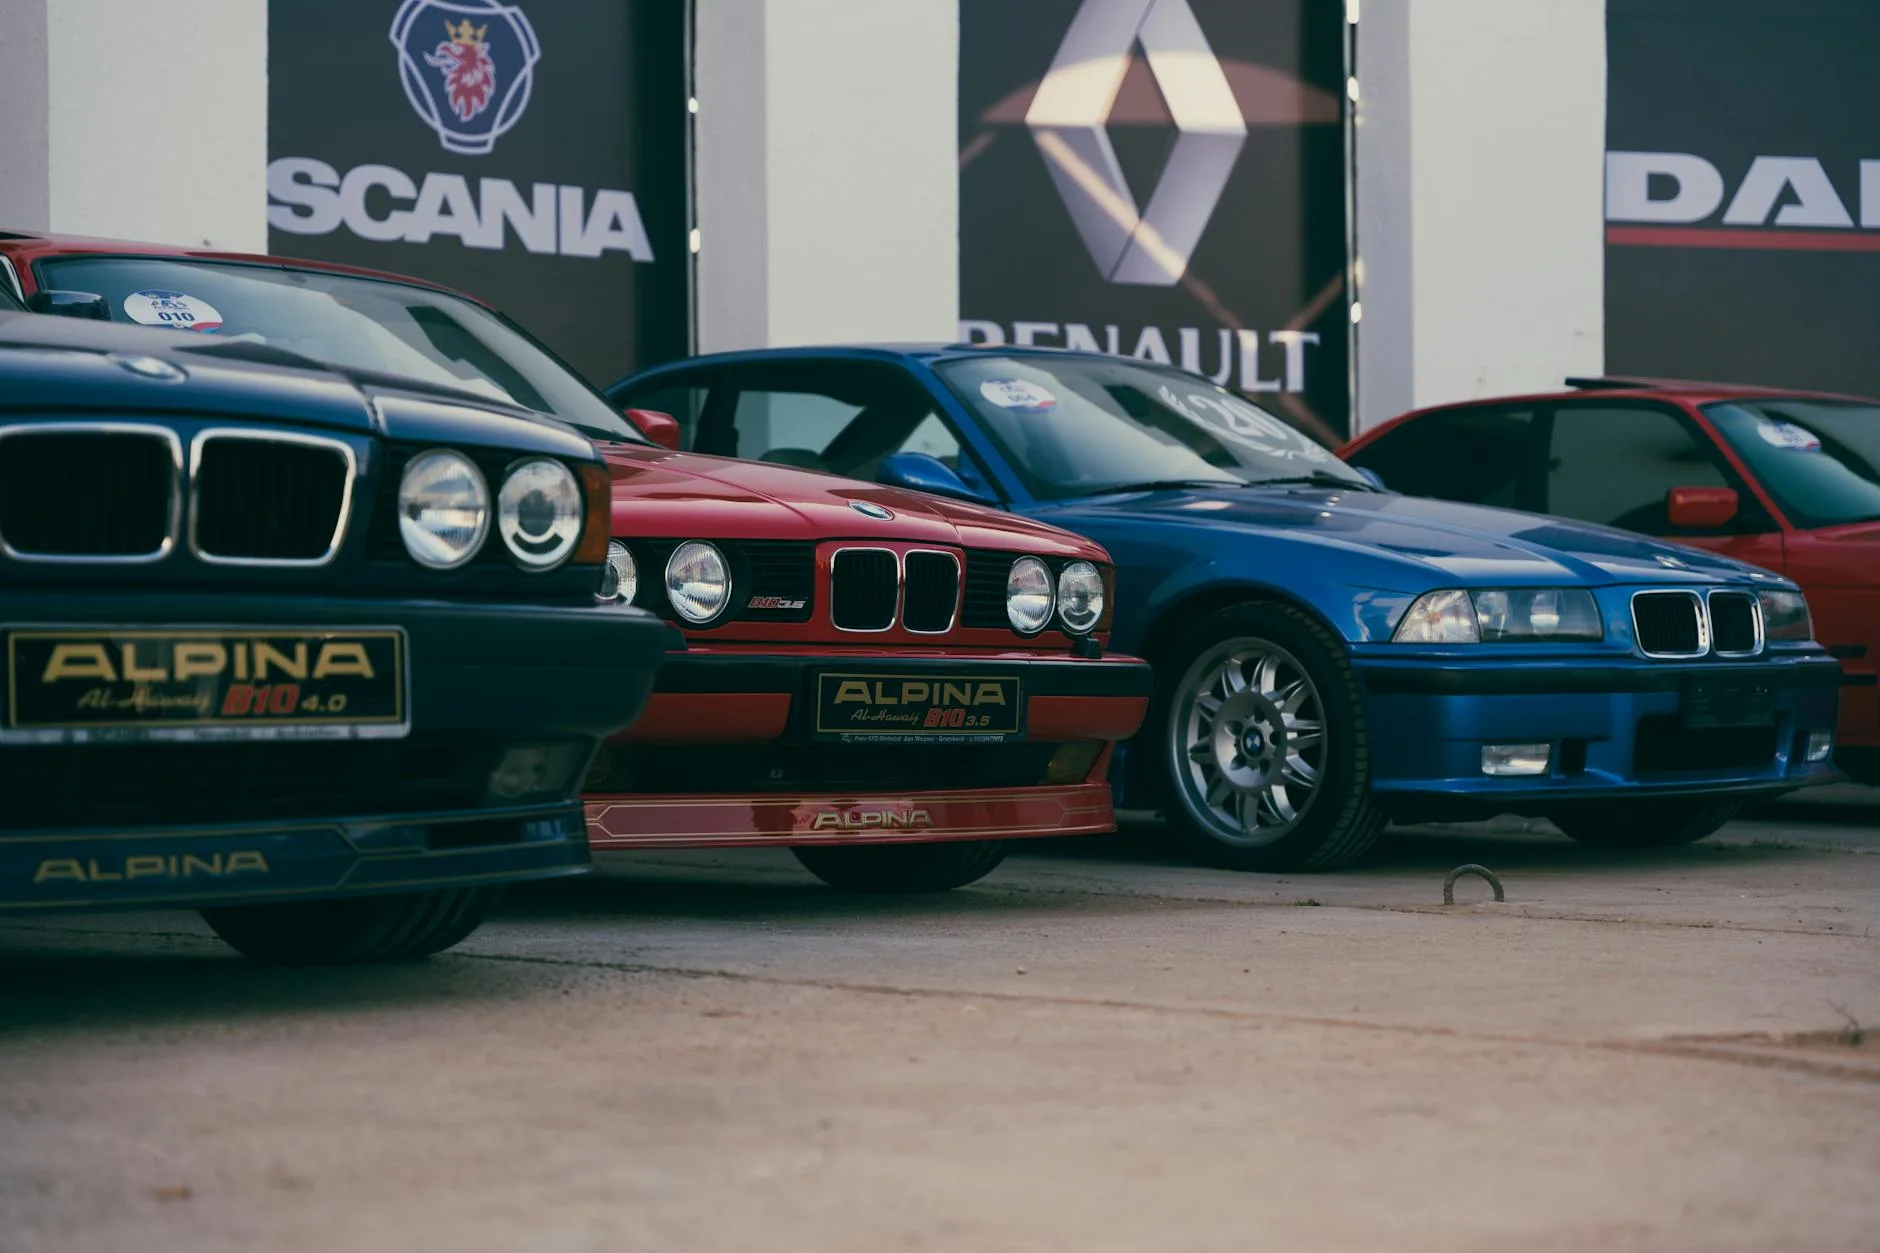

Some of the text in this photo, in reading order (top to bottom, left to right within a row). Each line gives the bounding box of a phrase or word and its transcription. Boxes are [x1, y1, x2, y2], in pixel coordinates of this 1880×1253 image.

[1605, 150, 1880, 228] DA
[267, 156, 655, 263] SCANIA
[158, 311, 195, 322] 010
[42, 642, 375, 683] ALPINA
[221, 684, 300, 716] B10
[301, 693, 348, 713] 4.0
[833, 680, 1006, 706] ALPINA
[923, 708, 966, 727] B10
[965, 715, 991, 727] 3.5
[814, 809, 934, 831] ALPINA
[33, 850, 270, 884] ALPINA
